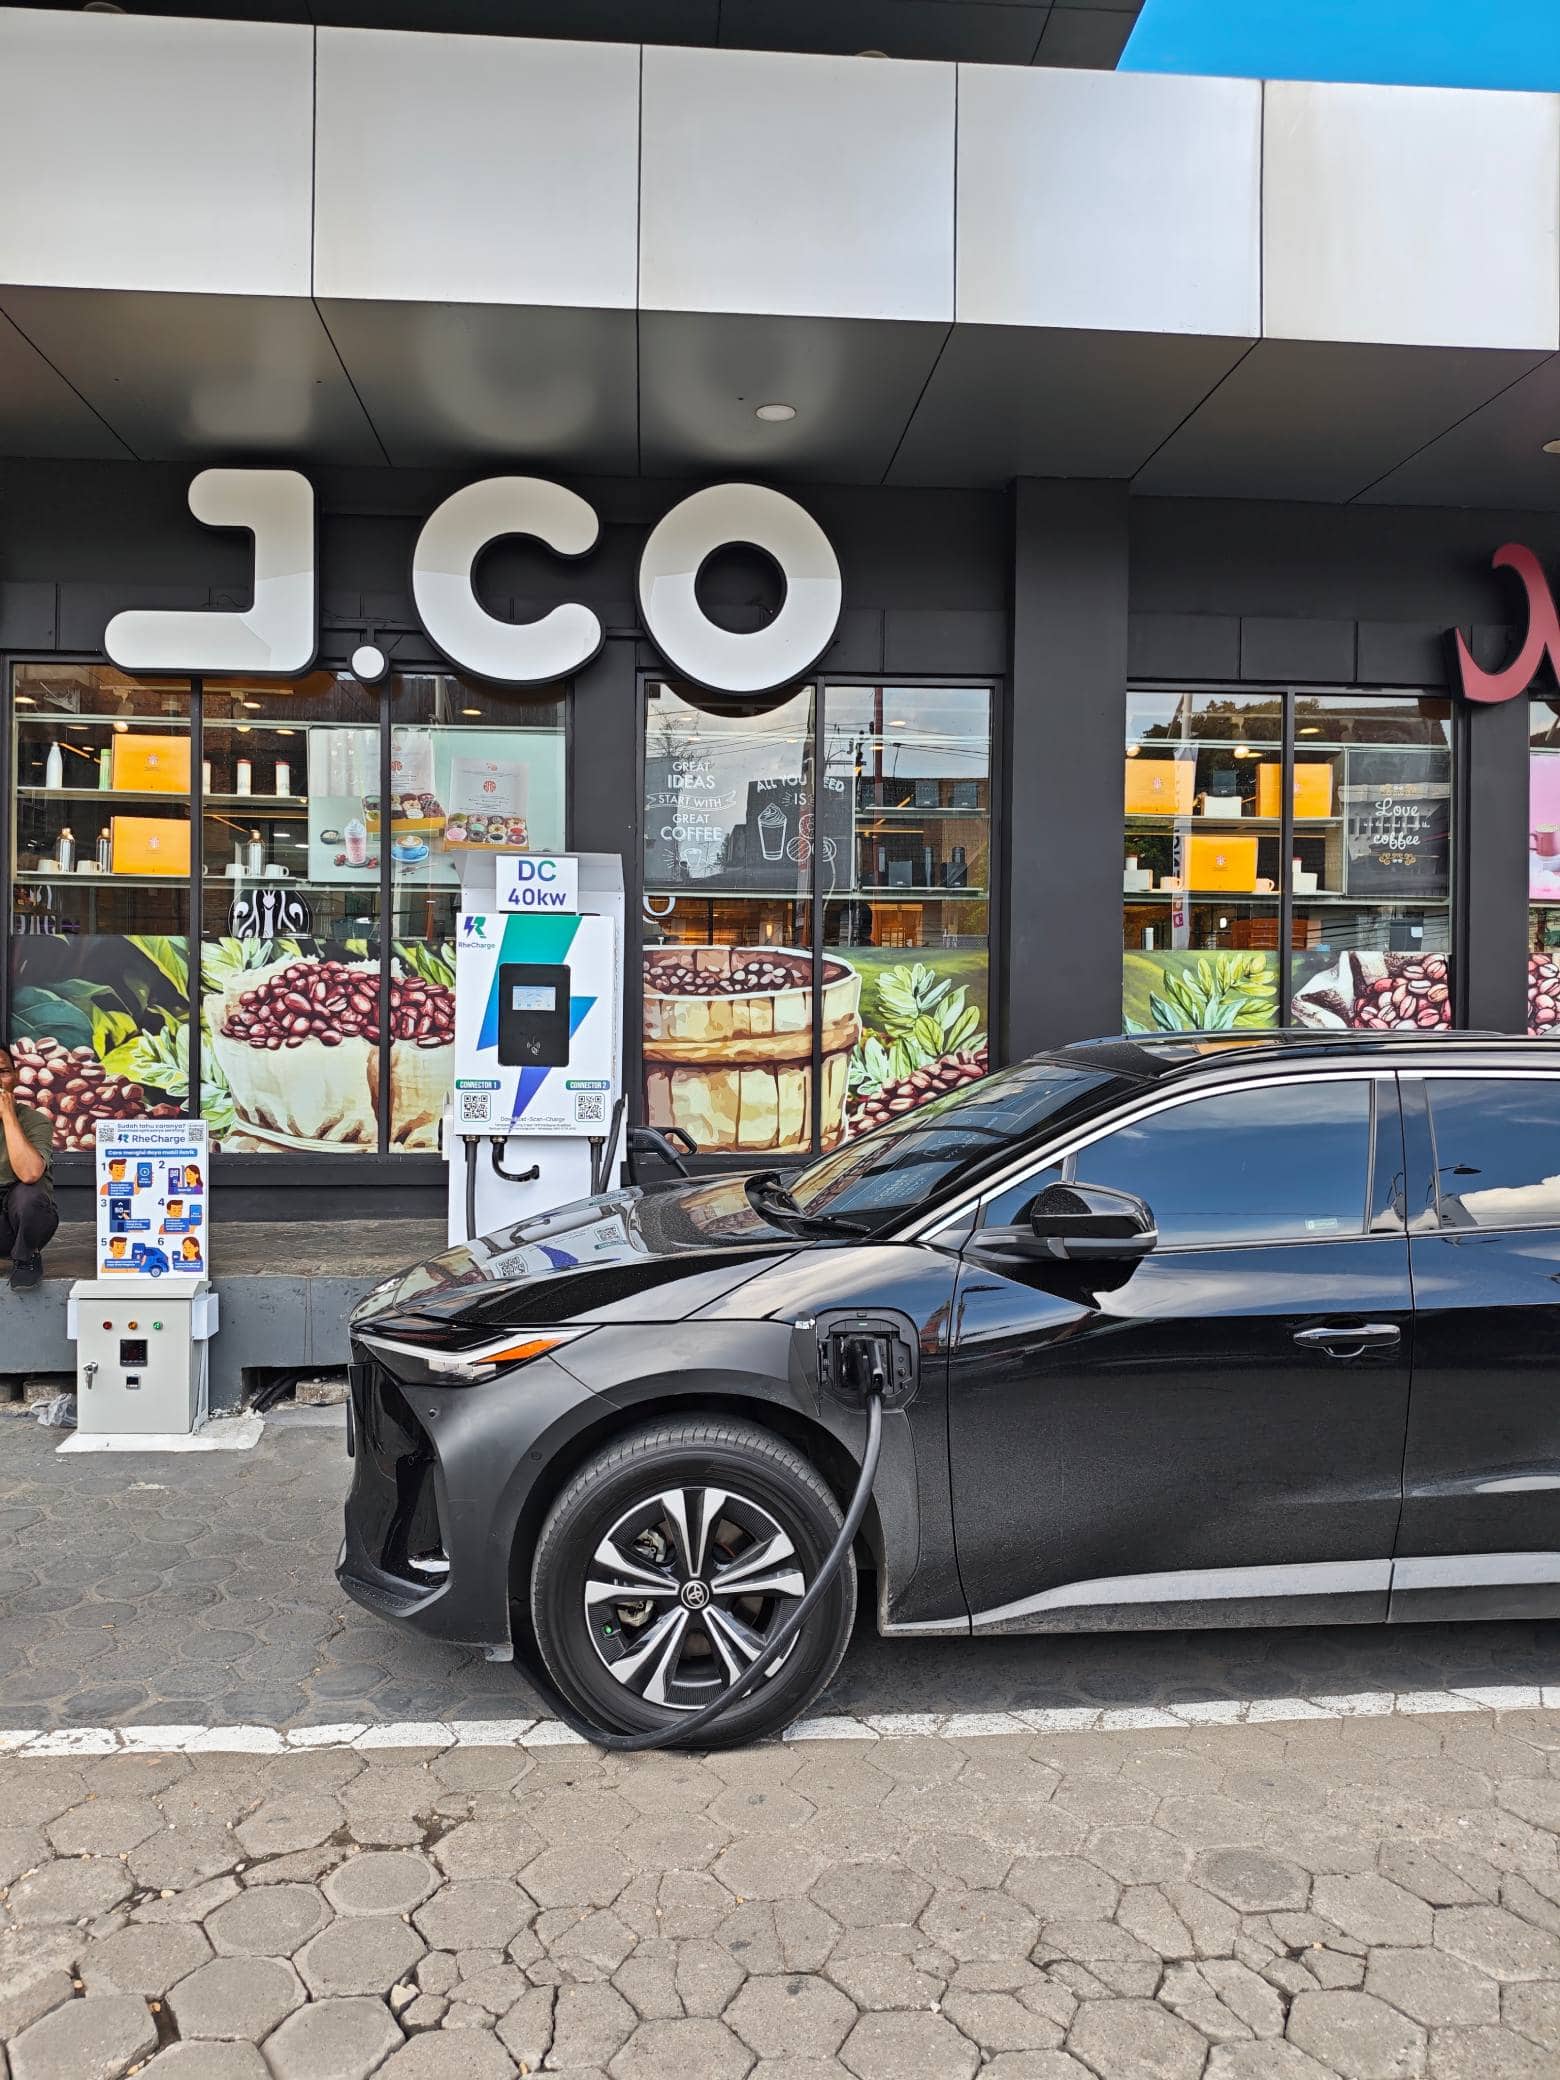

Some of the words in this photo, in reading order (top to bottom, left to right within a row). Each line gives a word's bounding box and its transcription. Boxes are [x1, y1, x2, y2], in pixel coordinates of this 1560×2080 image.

[104, 469, 842, 692] J.CO
[672, 761, 711, 772] GREAT
[667, 775, 716, 790] IDEAS
[756, 777, 777, 793] ALL
[658, 796, 690, 805] START
[694, 797, 722, 808] WITH
[794, 792, 807, 806] IS
[1375, 797, 1420, 817] Love
[672, 813, 710, 824] GREAT
[660, 826, 723, 842] COFFEE
[1373, 831, 1421, 850] coffee
[518, 859, 557, 882] DC
[508, 888, 567, 906] 40kw
[458, 941, 496, 949] RheCharge
[459, 1081, 493, 1089] CONNECTOR
[569, 1081, 602, 1089] CONNECTOR
[131, 1134, 186, 1144] RheCharge
[102, 1162, 106, 1171] 1
[158, 1160, 165, 1169] 2
[100, 1199, 107, 1207] 3
[158, 1198, 165, 1206] 4
[101, 1238, 107, 1246] 5
[158, 1238, 164, 1246] 6
